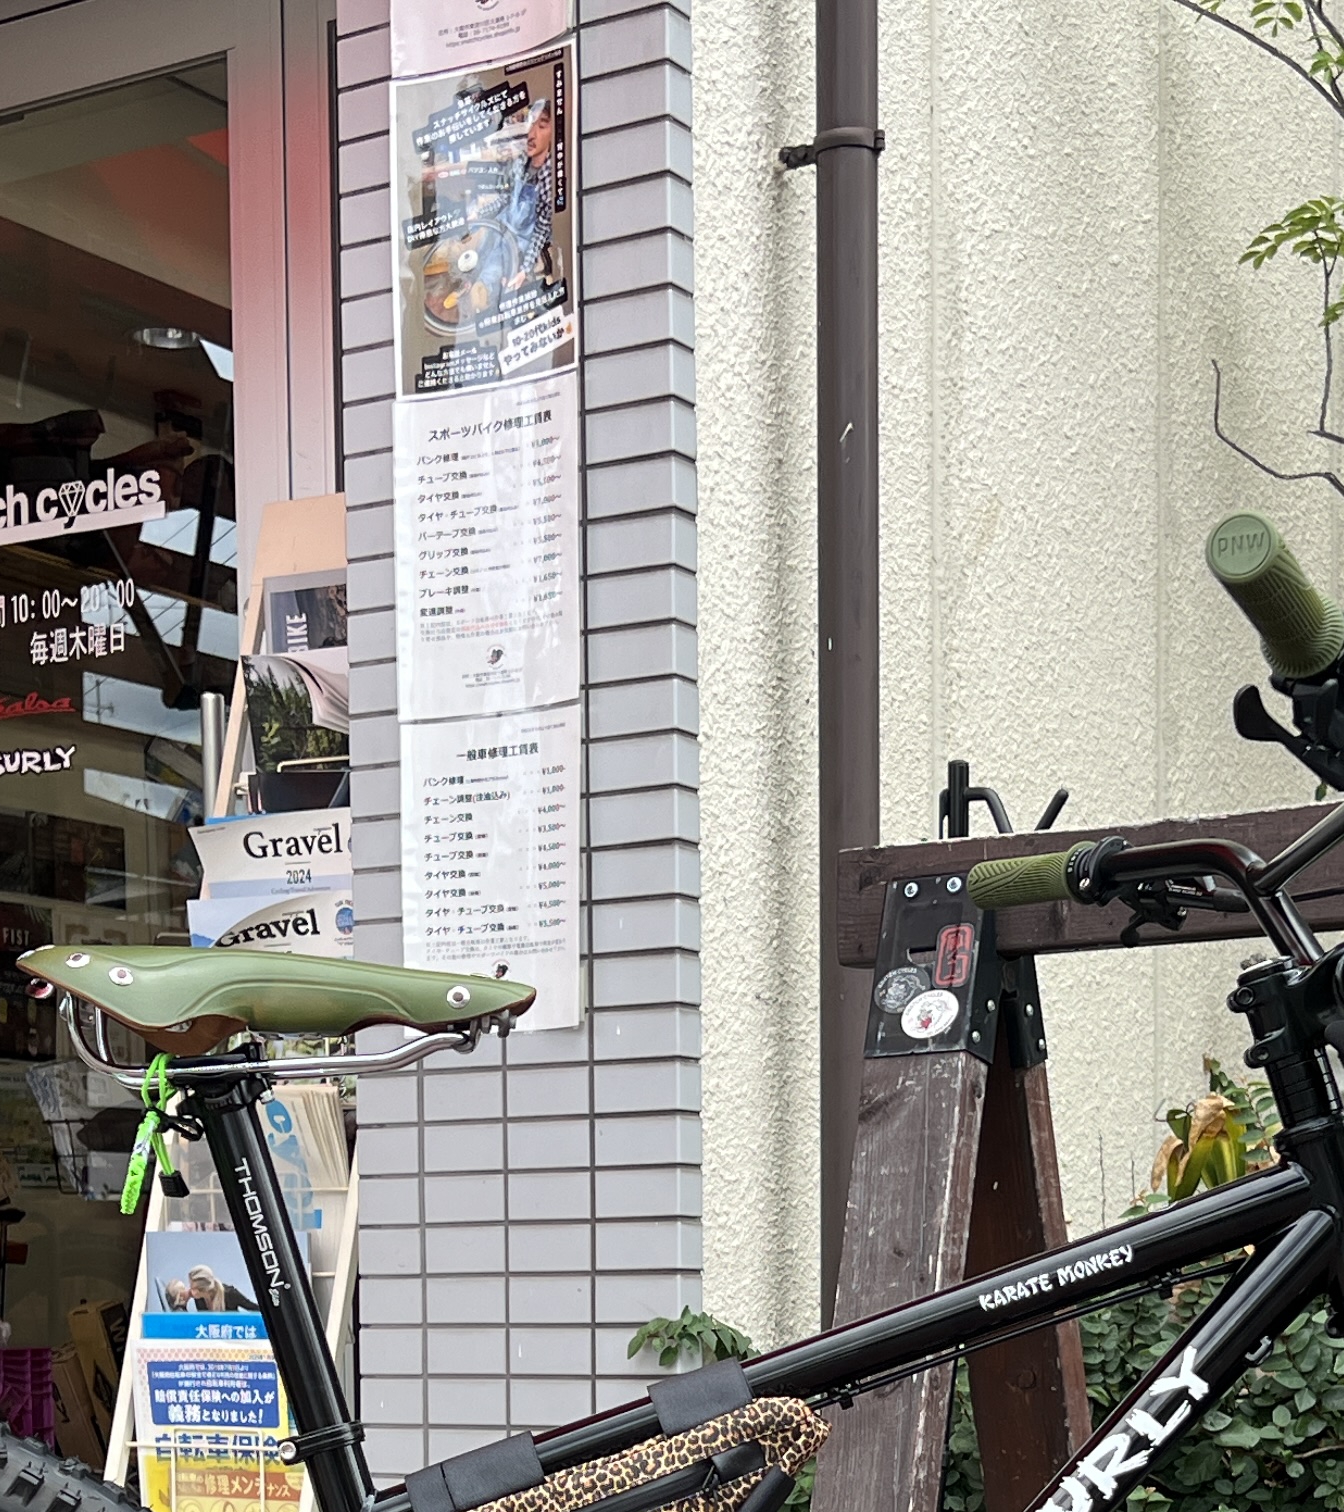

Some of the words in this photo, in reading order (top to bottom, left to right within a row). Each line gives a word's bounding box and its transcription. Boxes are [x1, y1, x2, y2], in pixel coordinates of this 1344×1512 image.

[428, 409, 552, 443] スポーツバイク修理工賃表
[418, 471, 468, 485] チューブ交換
[417, 490, 460, 504] タイヤ交換
[418, 504, 498, 523] タイヤ・チューブ交換
[418, 527, 476, 542] バーテープ交換
[1217, 530, 1265, 554] PNW
[418, 547, 468, 561] グリップ交換
[419, 566, 469, 580] チェーン交換
[419, 585, 469, 599] ブレーキ調整
[30, 622, 126, 666] 毎週木曜日
[456, 742, 539, 761] 一般車修理工賃表
[424, 812, 473, 824] チェーン交換
[243, 822, 343, 859] Gravel
[424, 831, 473, 843] チューブ交換
[424, 850, 473, 862] チューブ交換
[286, 868, 312, 885] 2024
[424, 869, 466, 880] タイヤ交換
[425, 888, 466, 899] タイヤ交換
[425, 904, 504, 918] タイヤ・チューブ交換
[214, 908, 320, 948] Gravel
[425, 923, 505, 937] タイヤ・チューブ交換
[2, 927, 30, 946] FIST
[235, 1156, 285, 1288] THOMSON
[979, 1272, 1054, 1312] KARATE
[1056, 1244, 1135, 1289] MONKEY
[195, 1324, 257, 1339] 大阪府では
[154, 1389, 275, 1404] 賠償責任保険への加入が
[155, 1433, 280, 1464] 自転車保険
